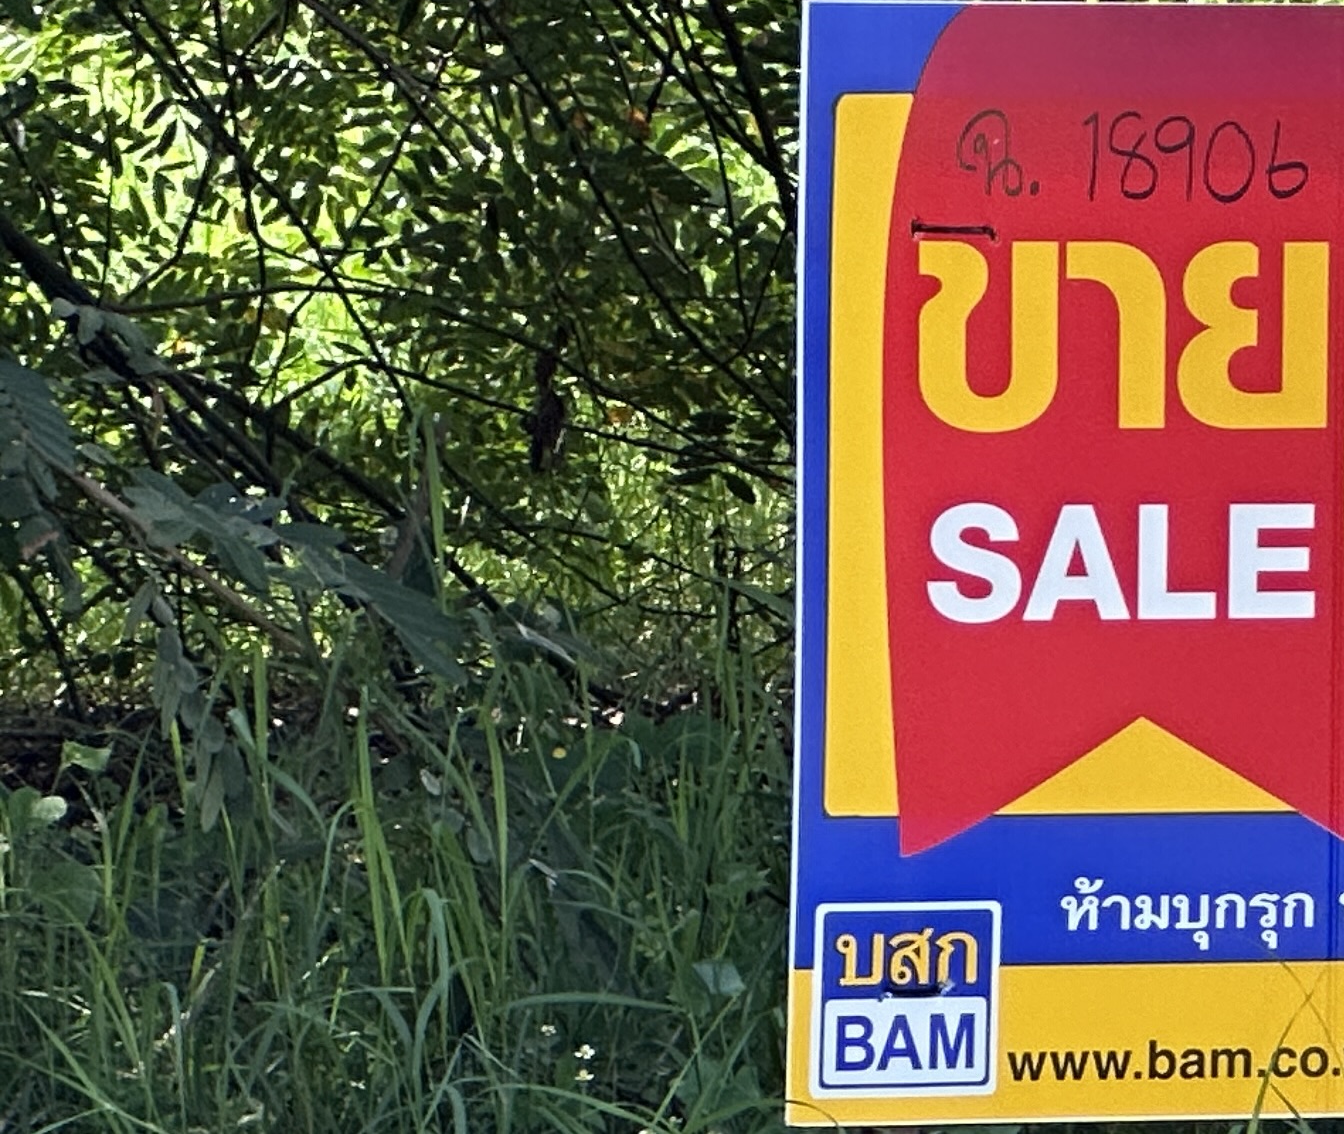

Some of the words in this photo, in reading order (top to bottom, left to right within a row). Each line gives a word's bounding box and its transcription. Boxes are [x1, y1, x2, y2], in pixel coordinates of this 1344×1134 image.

[1083, 111, 1309, 203] 18906
[918, 241, 1330, 433] ขาย
[926, 502, 1315, 623] SALE
[1060, 876, 1316, 950] ห้ามบุกรุก
[836, 930, 978, 987] บสก
[834, 1013, 975, 1072] BAM
